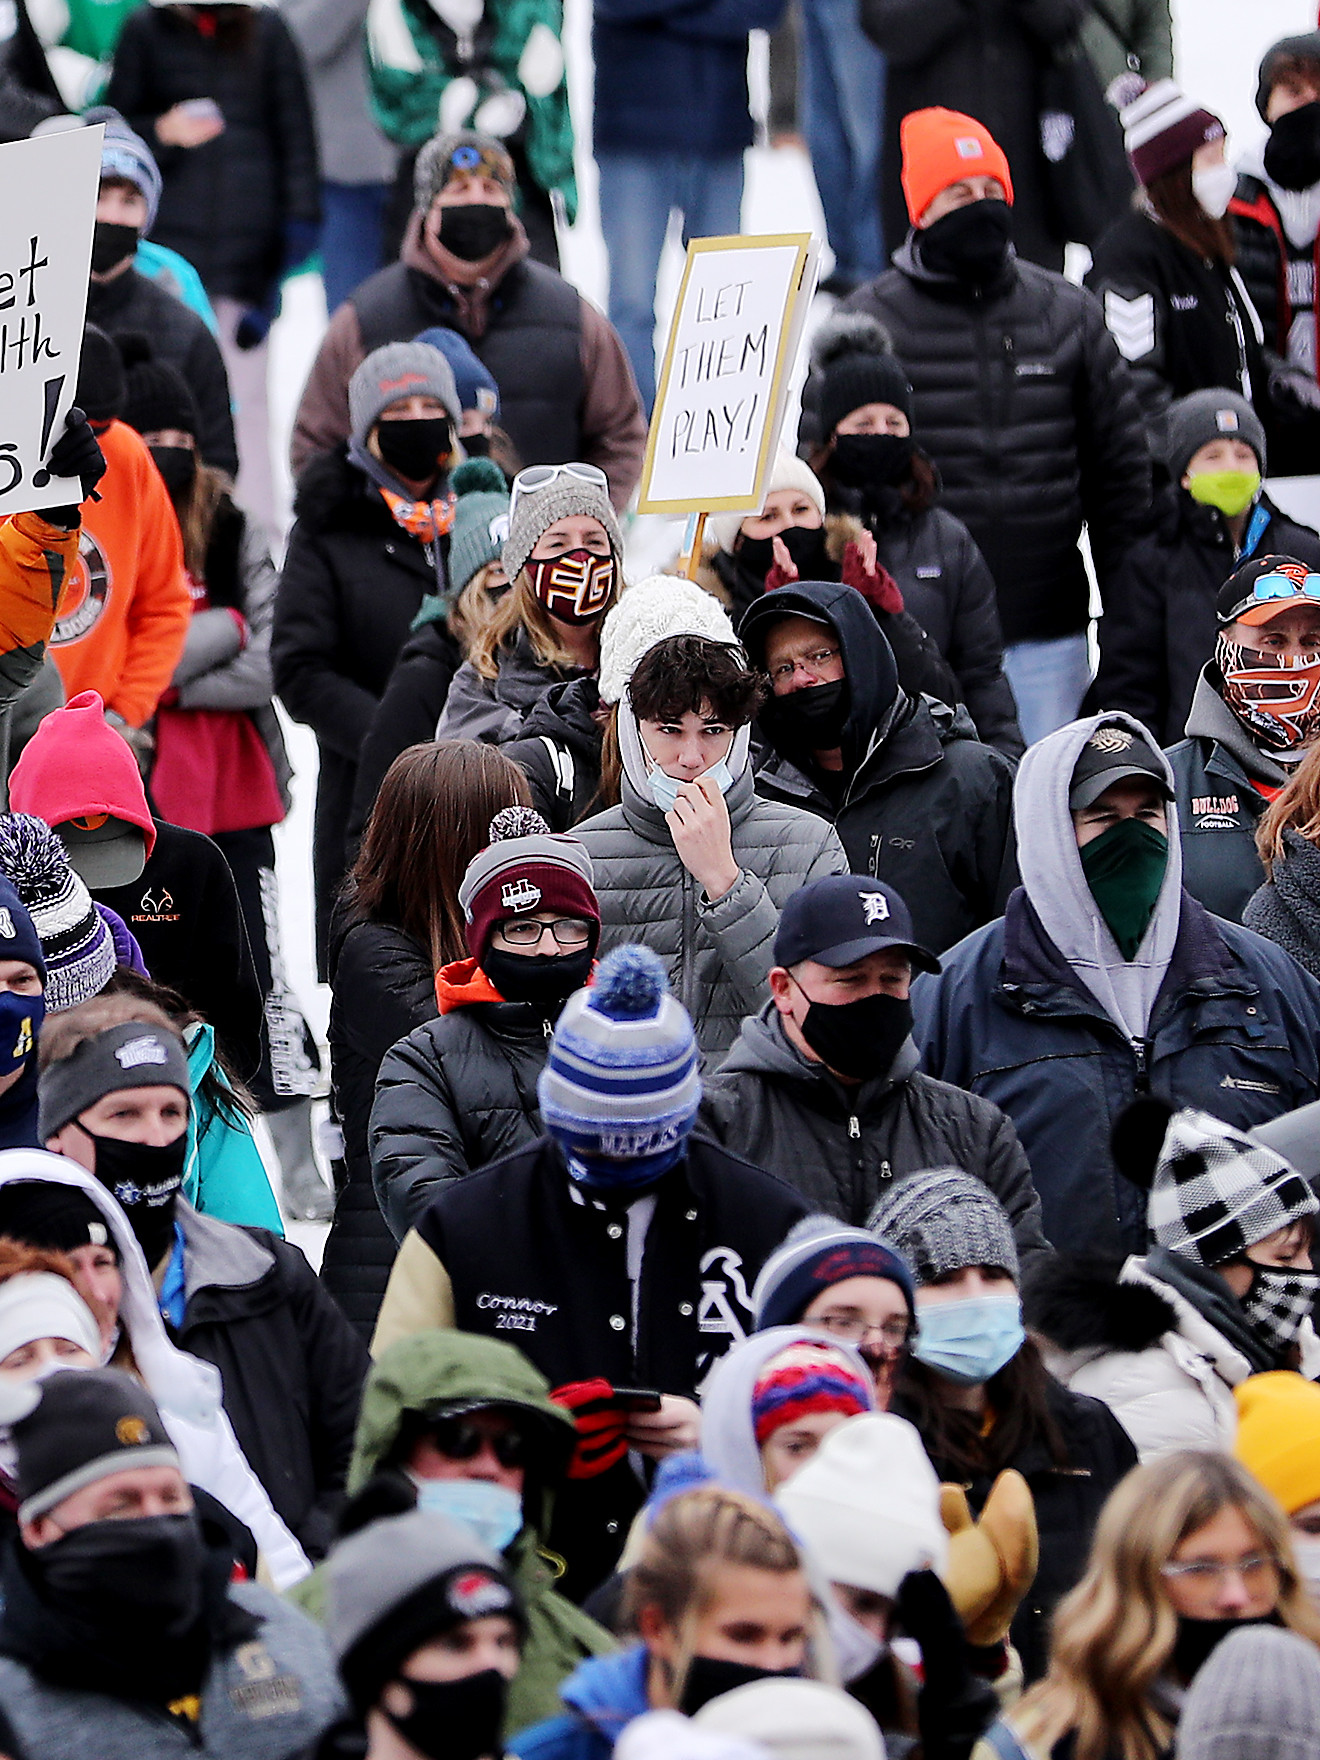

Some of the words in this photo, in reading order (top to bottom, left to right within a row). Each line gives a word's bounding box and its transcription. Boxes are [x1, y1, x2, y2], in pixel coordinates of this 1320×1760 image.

[697, 281, 753, 323] LET
[679, 323, 768, 390] THEM
[672, 393, 759, 459] PLAY!
[1191, 794, 1240, 815] BULLDOG
[131, 913, 180, 923] REALTREE
[858, 891, 891, 926] D
[476, 1292, 558, 1316] Connor
[495, 1312, 537, 1332] 2021
